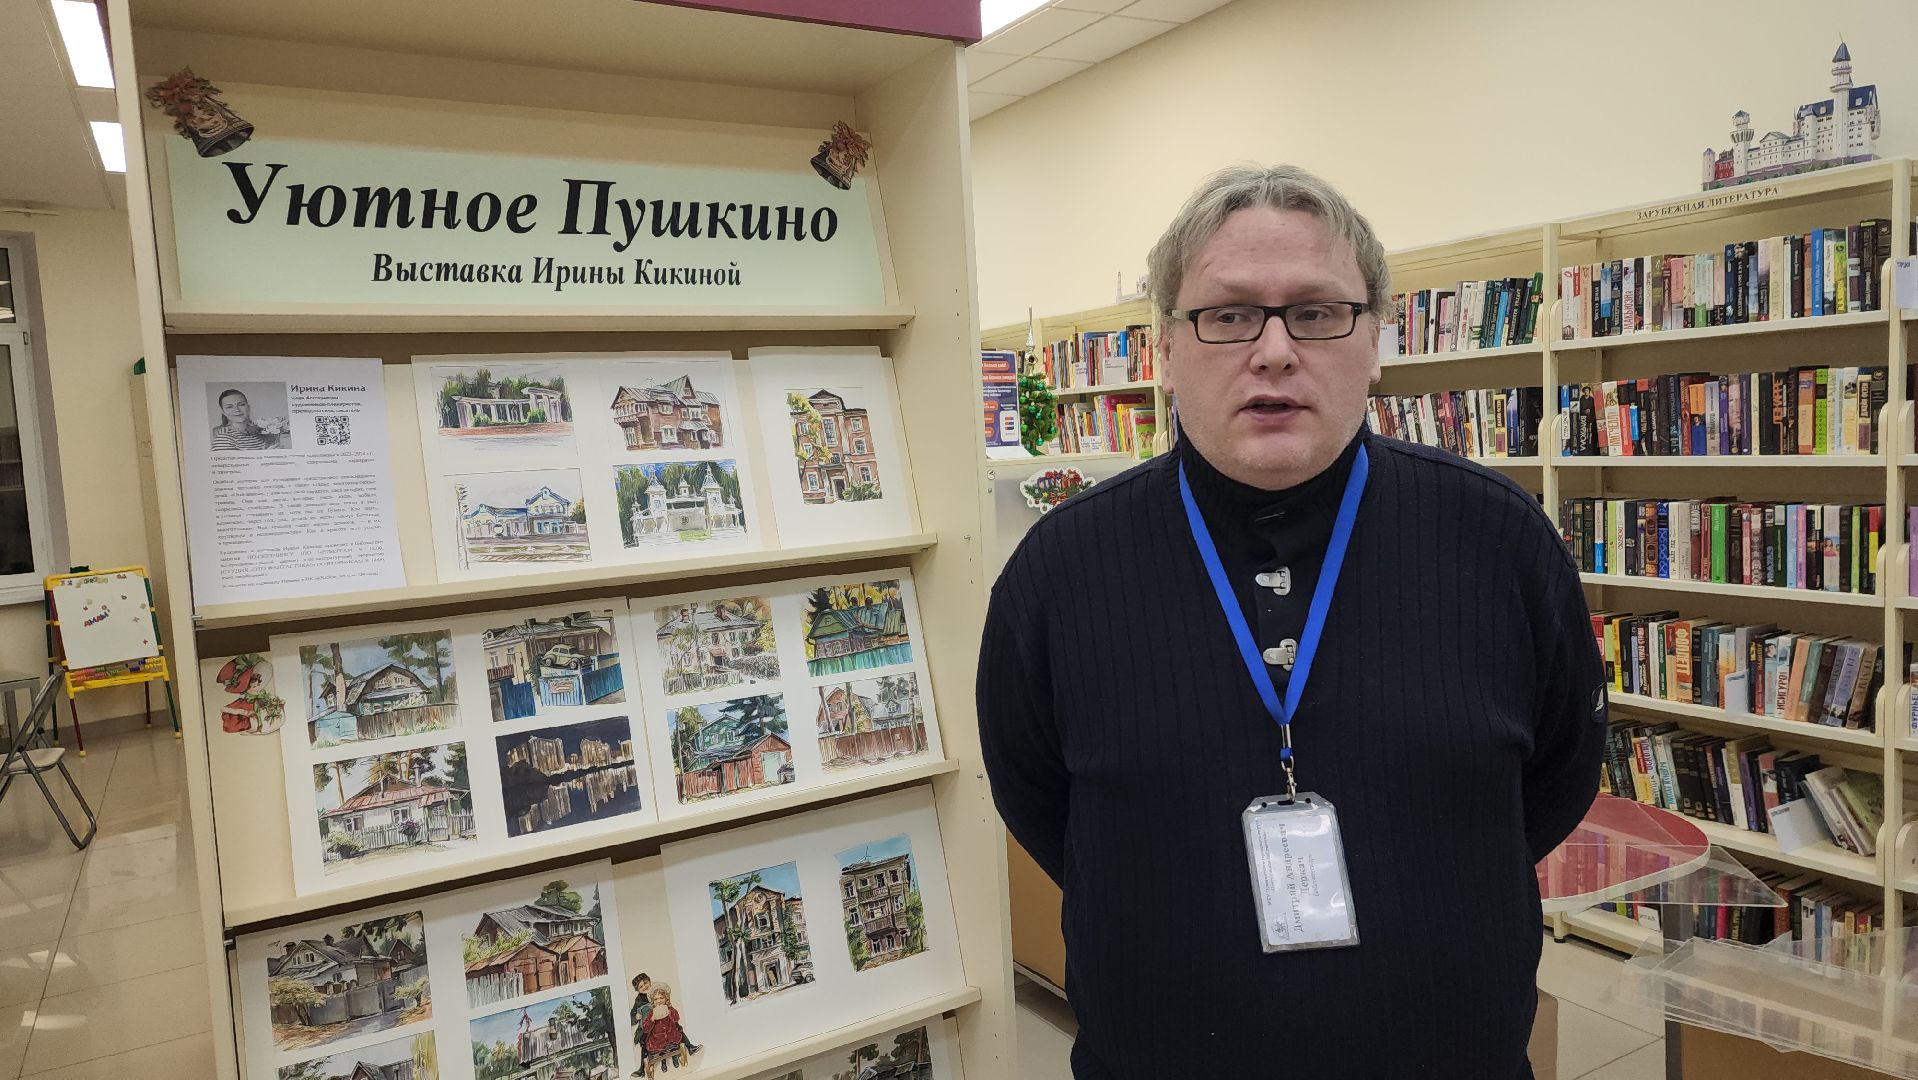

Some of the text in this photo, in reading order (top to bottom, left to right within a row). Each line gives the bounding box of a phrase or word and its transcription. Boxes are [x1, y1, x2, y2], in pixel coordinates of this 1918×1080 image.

[222, 161, 838, 253] Уютное Пушкино
[1636, 187, 1779, 221] ЗАРУБЕЖНАЯ ЛИТЕРАТУРА
[370, 253, 742, 292] Выставка Ирины Кикиной
[290, 384, 366, 394] Ирина Кикина
[1279, 823, 1304, 933] Дмитрий Андреевич
